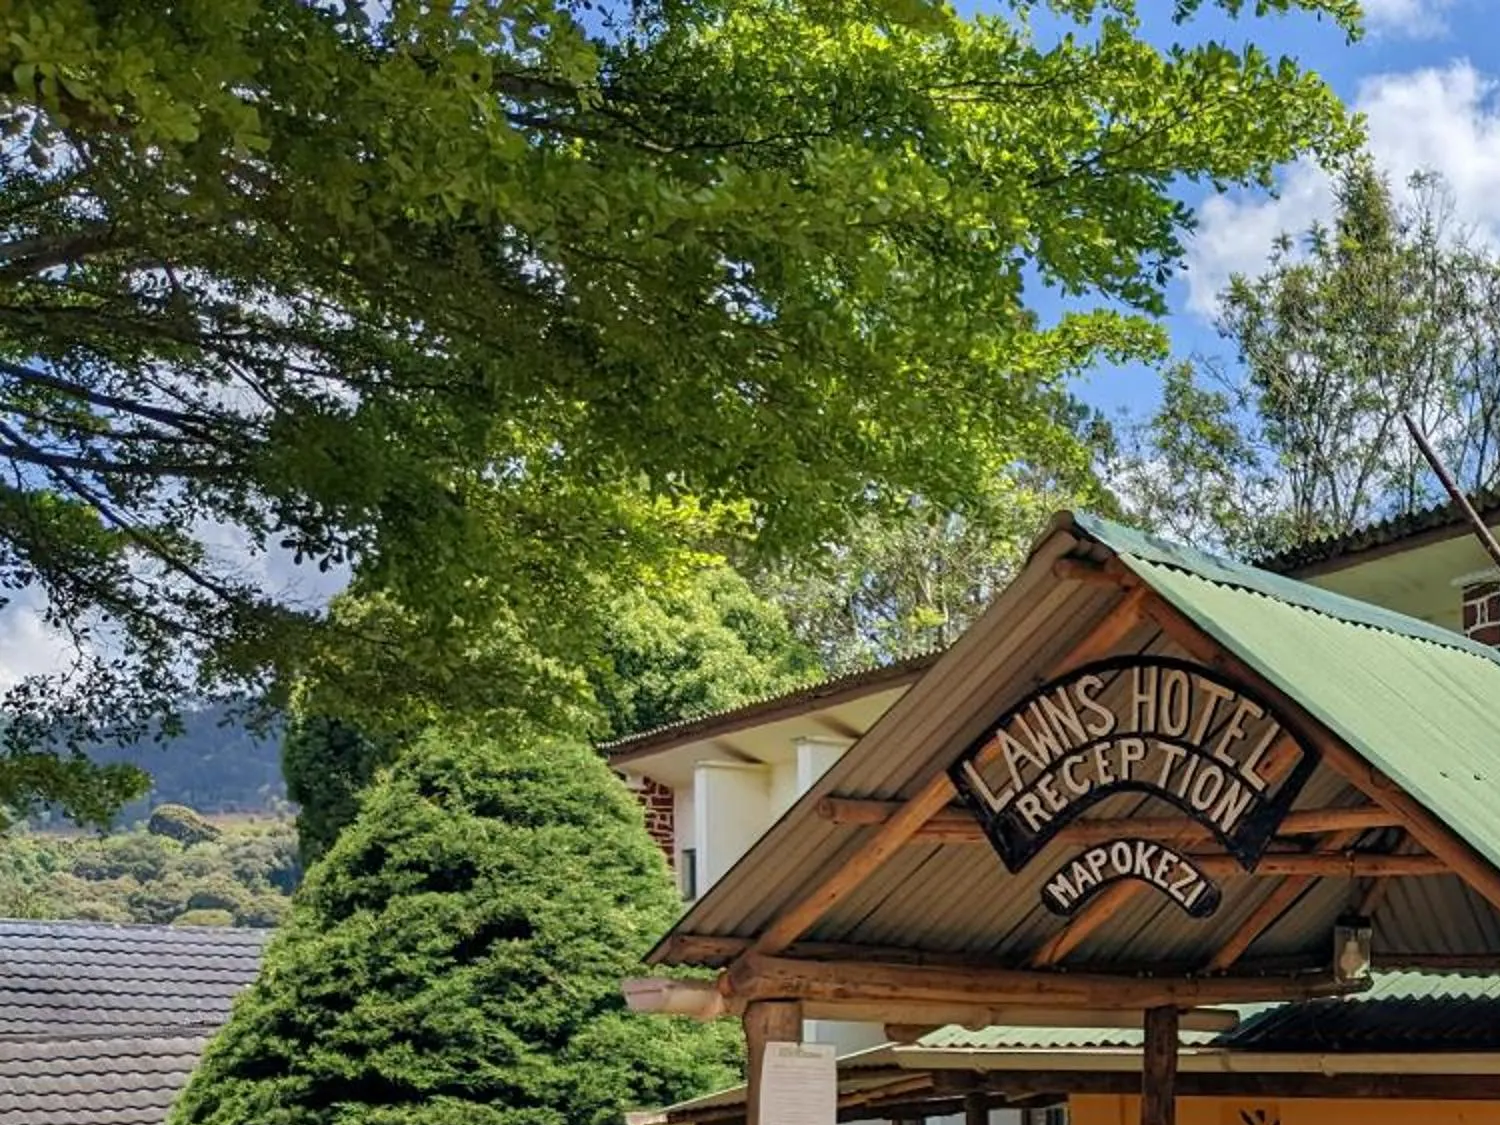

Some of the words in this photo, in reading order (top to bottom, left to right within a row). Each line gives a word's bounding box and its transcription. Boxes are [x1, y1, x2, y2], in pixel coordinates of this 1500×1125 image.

[962, 674, 1116, 814] LAWNS
[1131, 665, 1281, 793] HOTEL
[1015, 738, 1253, 833] RECEPTION
[1045, 840, 1207, 909] MAPOKEZI
